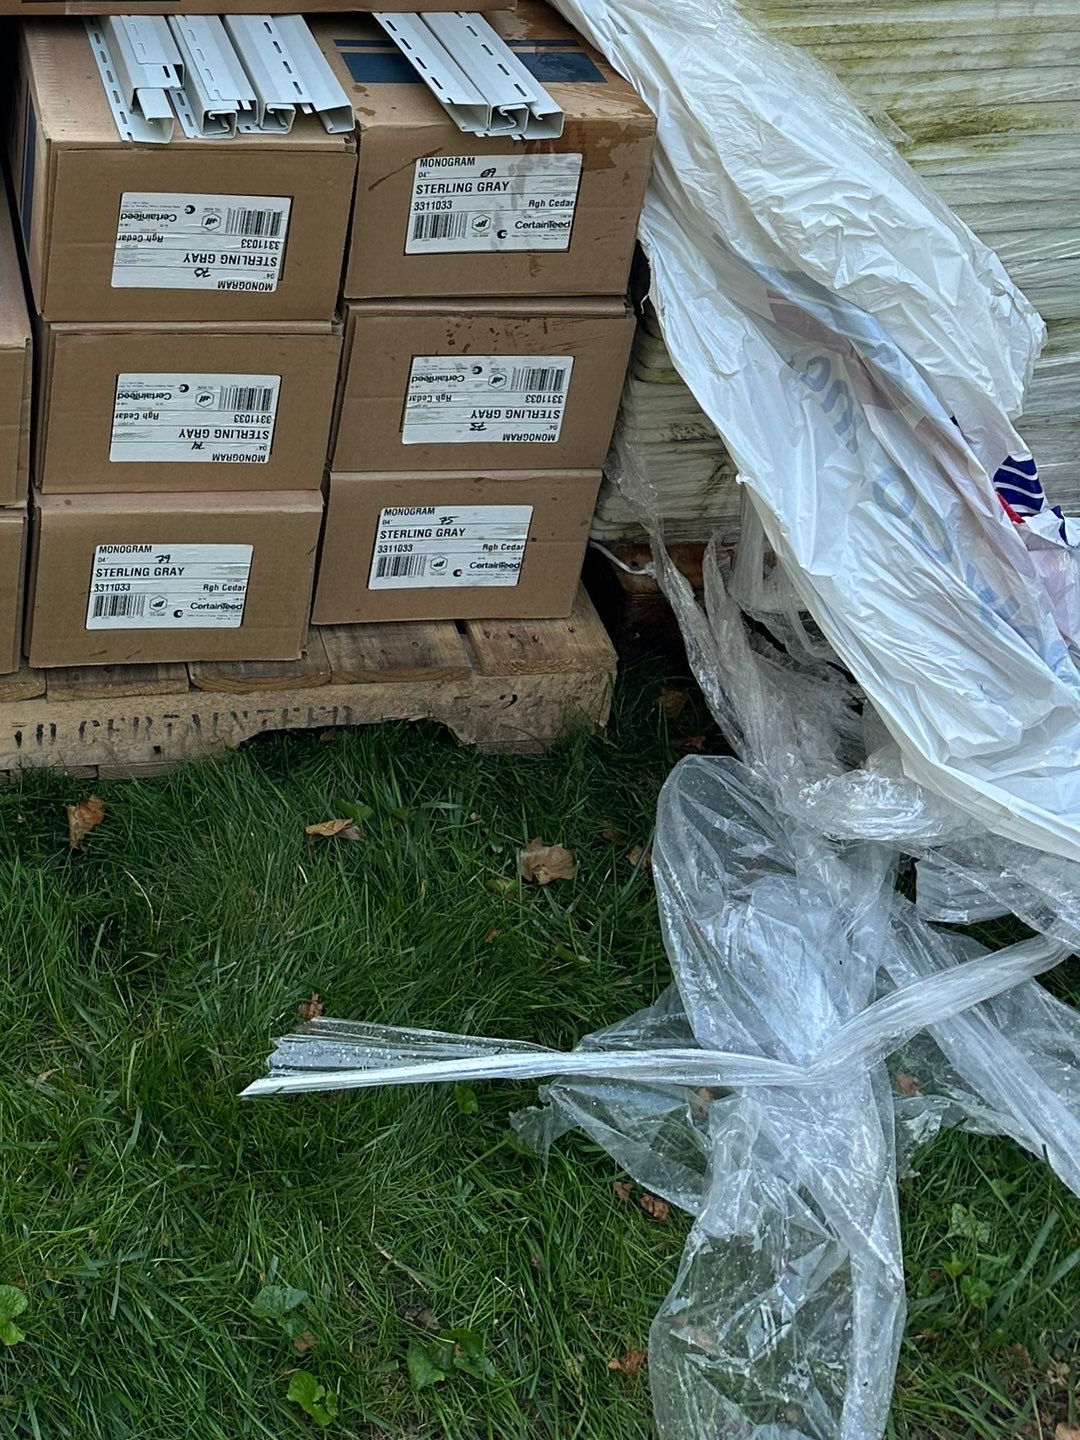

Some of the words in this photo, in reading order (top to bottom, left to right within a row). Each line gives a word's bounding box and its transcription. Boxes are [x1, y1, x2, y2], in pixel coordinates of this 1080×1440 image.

[420, 157, 476, 168] MONOGRAM
[416, 183, 472, 194] STERLING
[477, 181, 510, 192] GRAY
[414, 200, 453, 211] 3311033
[528, 200, 545, 208] Rgh
[549, 199, 574, 207] Cedar
[120, 213, 177, 222] CertainTeed
[515, 220, 571, 230] CertainTeed
[241, 239, 280, 250] 3311033
[183, 253, 216, 264] GRAY
[221, 254, 277, 267] STERLING
[217, 280, 273, 291] MONOGRAM
[525, 395, 563, 403] 3311033
[234, 414, 271, 423] 3311033
[470, 409, 501, 419] GRAY
[505, 409, 560, 419] STERLING
[178, 428, 210, 439] GRAY
[214, 429, 269, 440] STERLING
[503, 433, 556, 442] MONOGRAM
[212, 453, 266, 462] MONOGRAM
[384, 508, 435, 516] MONOGRAM
[380, 529, 432, 539] STERLING
[436, 528, 466, 537] GRAY
[99, 545, 152, 554] MONOGRAM
[378, 544, 413, 553] 3311033
[96, 568, 150, 577] STERLING
[154, 567, 185, 576] GRAY
[94, 584, 131, 592] 3311033
